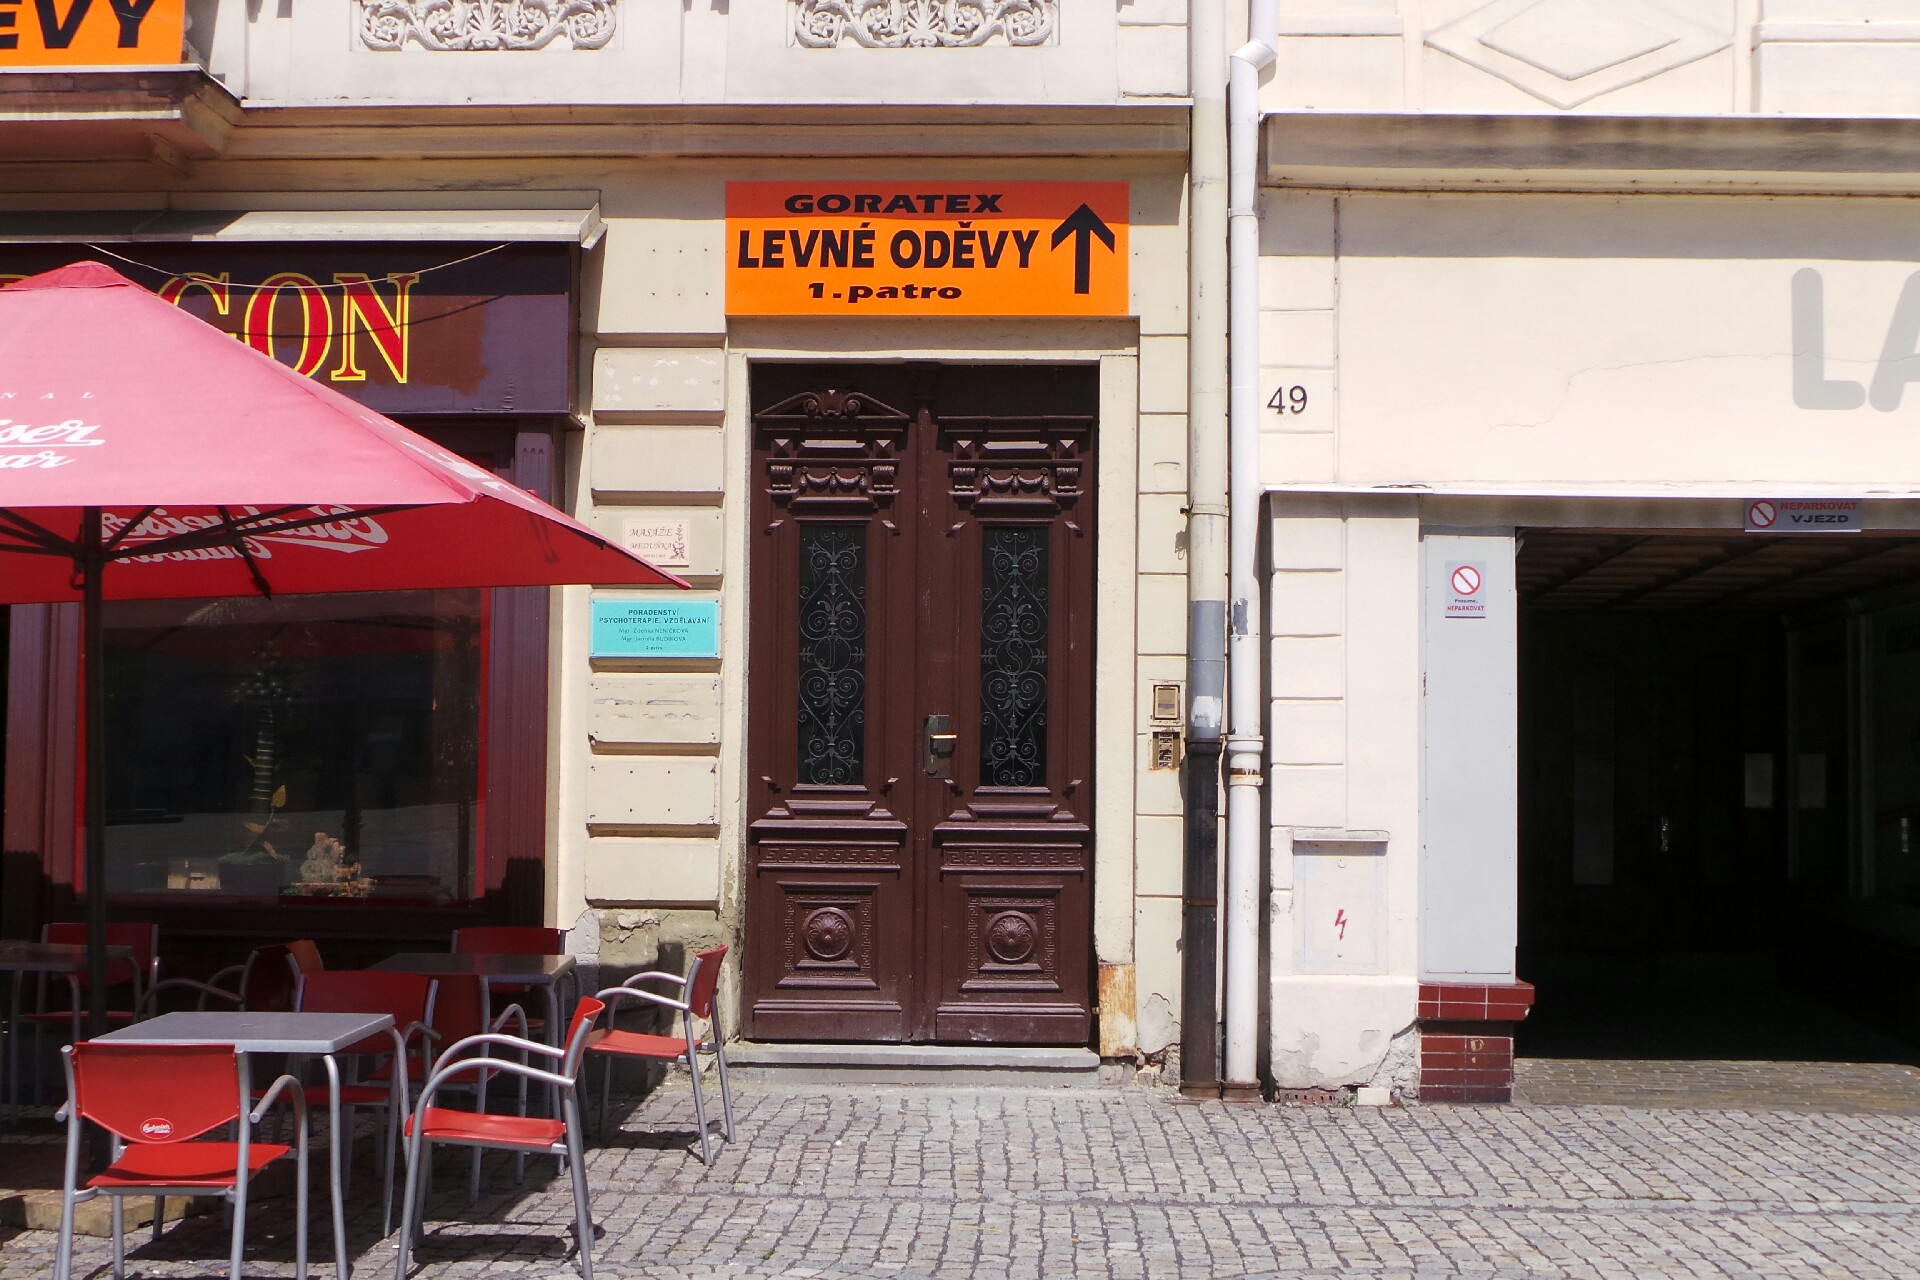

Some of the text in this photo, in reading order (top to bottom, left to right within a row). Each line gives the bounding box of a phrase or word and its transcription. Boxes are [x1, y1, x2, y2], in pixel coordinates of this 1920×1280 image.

[784, 194, 1004, 214] GORATEX
[737, 221, 1040, 269] LEVNÉ ODĚVY
[807, 282, 963, 304] 1.patro
[1266, 385, 1308, 415] 49
[1779, 501, 1858, 511] NEPARKOVAT
[1791, 514, 1849, 523] VJEZD
[629, 526, 673, 537] MASÁŽE
[628, 608, 680, 616] PORADENSTVÍ
